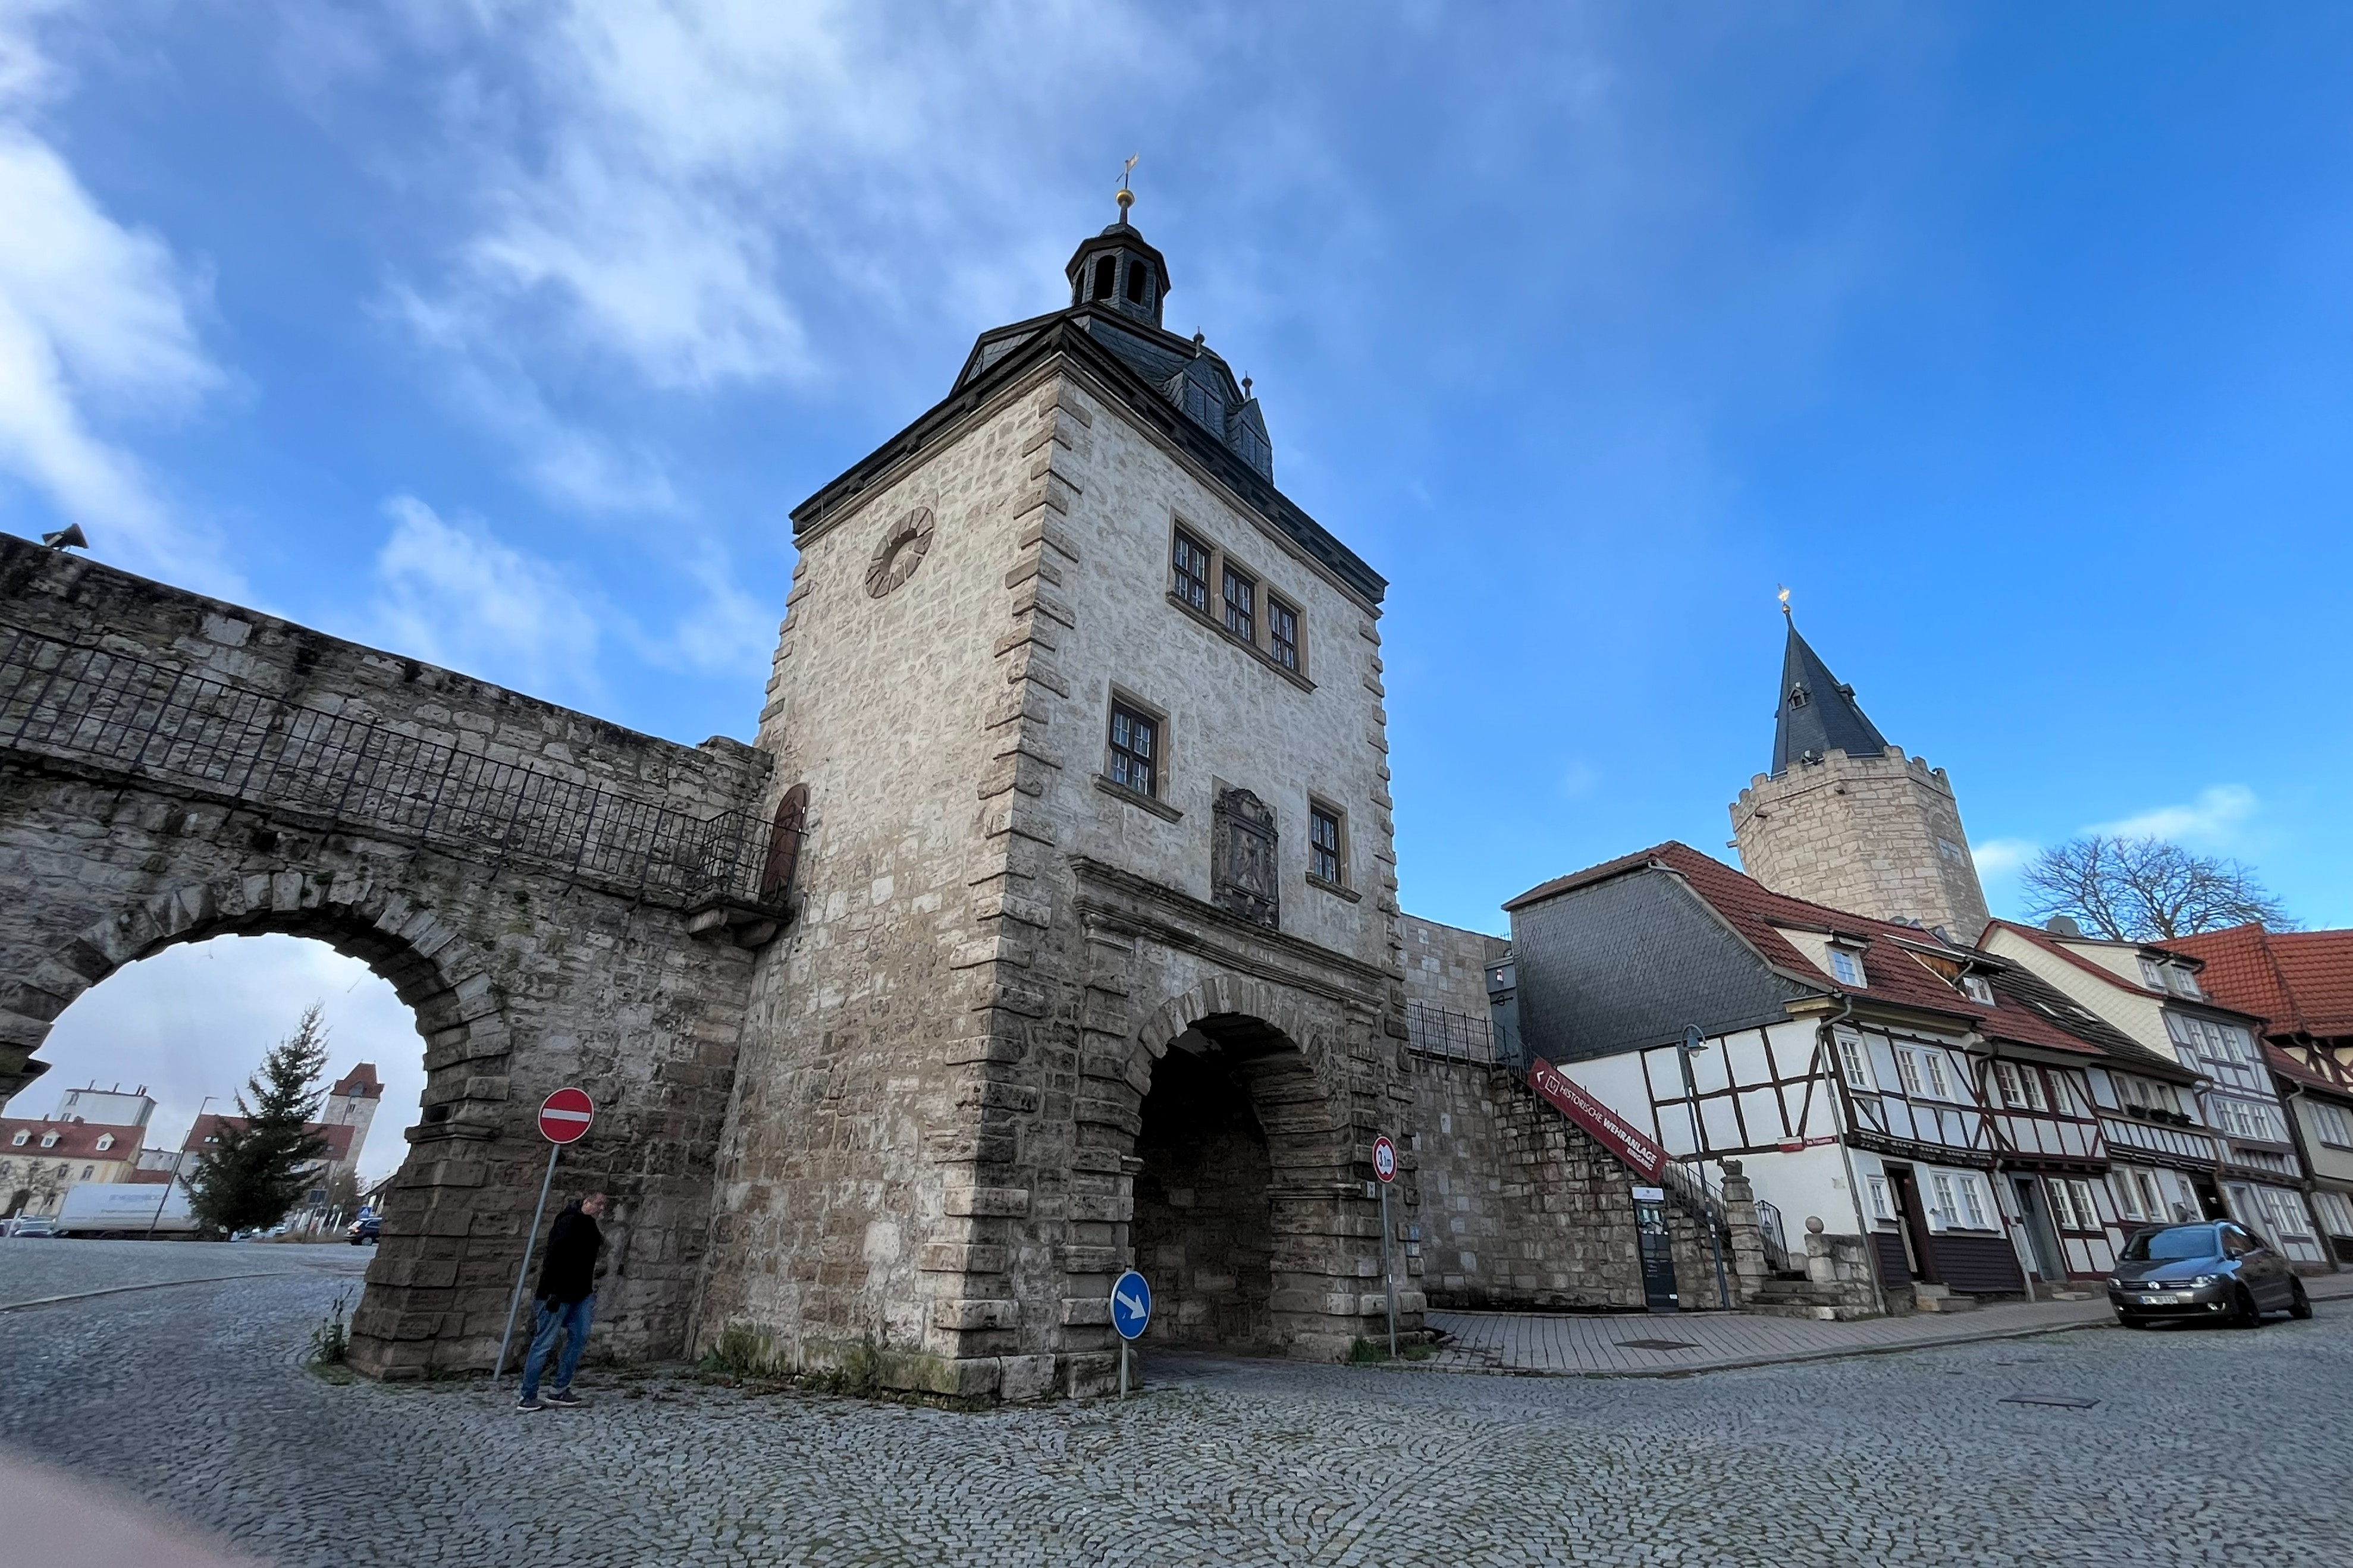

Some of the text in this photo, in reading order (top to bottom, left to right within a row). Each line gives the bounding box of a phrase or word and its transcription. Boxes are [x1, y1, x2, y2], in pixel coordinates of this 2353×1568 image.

[1560, 1085, 1657, 1164] HISTORISCHE WEHRANLAGE
[1627, 1147, 1654, 1171] EINGANG
